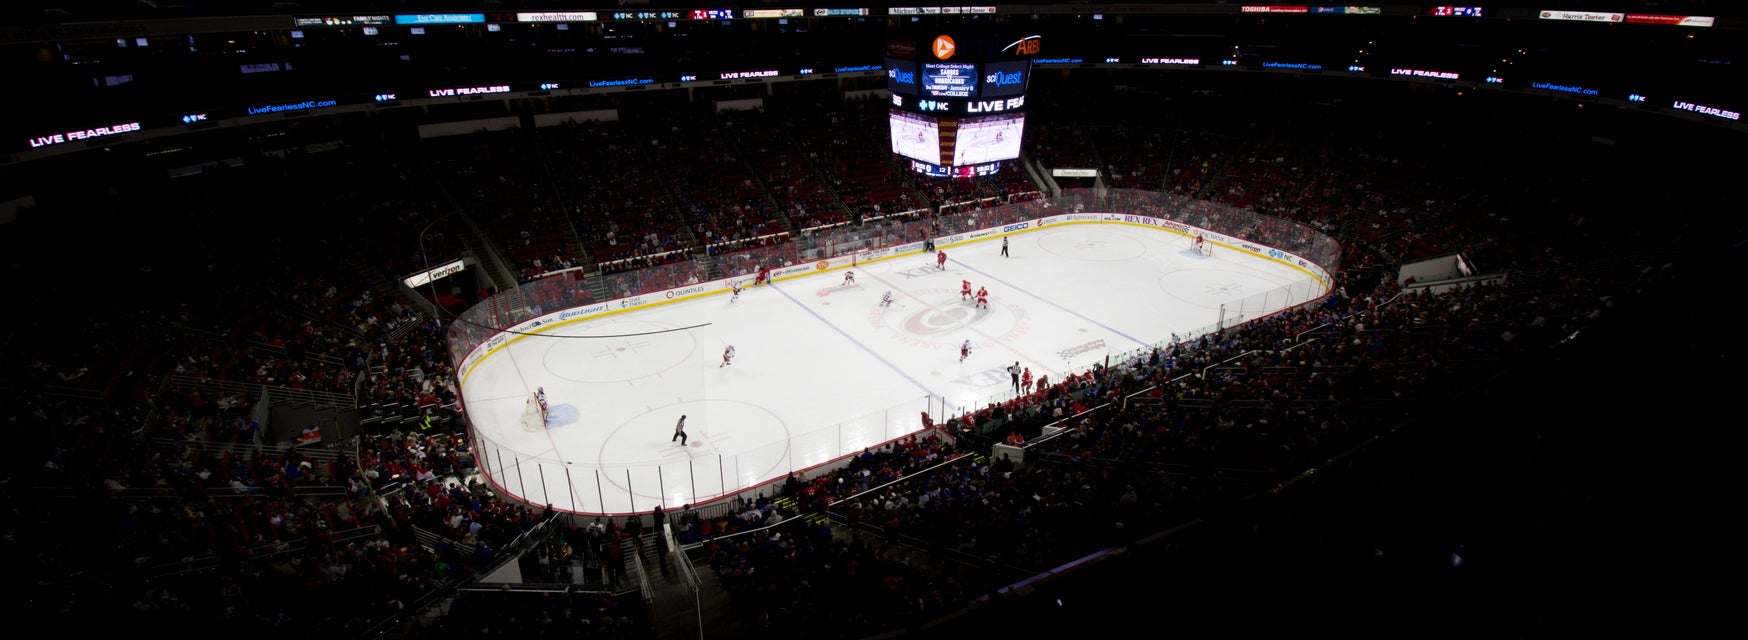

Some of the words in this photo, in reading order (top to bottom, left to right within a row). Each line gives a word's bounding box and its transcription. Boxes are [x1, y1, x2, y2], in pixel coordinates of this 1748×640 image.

[1241, 5, 1270, 13] TOSHIBA
[532, 13, 584, 21] rexhealth.com
[1262, 62, 1322, 70] LiveFearlessNC.com
[888, 68, 915, 84] sciQuest
[987, 71, 1022, 87] sciQuest
[1391, 68, 1411, 77] LIVE
[1413, 70, 1460, 80] FEARLESS
[589, 78, 653, 88] LiveFearlessNC.com
[430, 89, 454, 97] LIVE
[456, 86, 510, 96] FEARLESS
[1532, 82, 1599, 96] LiveFearlessNC.com
[248, 100, 336, 115] LiveFearlessNC.com
[937, 102, 949, 111] NC
[968, 100, 1004, 112] LIVE
[1674, 101, 1694, 111] LIVE
[1695, 105, 1741, 120] FEARLESS
[30, 134, 64, 148] LIVE
[67, 122, 140, 140] FEARLESS
[1125, 215, 1141, 223] REX
[1143, 216, 1158, 226] REX
[1003, 223, 1029, 232] GEICO
[1242, 244, 1261, 252] verizon
[1283, 254, 1293, 262] NC
[433, 264, 461, 278] verizon
[676, 287, 705, 297] QUINTILES
[580, 306, 604, 316] LIGHT
